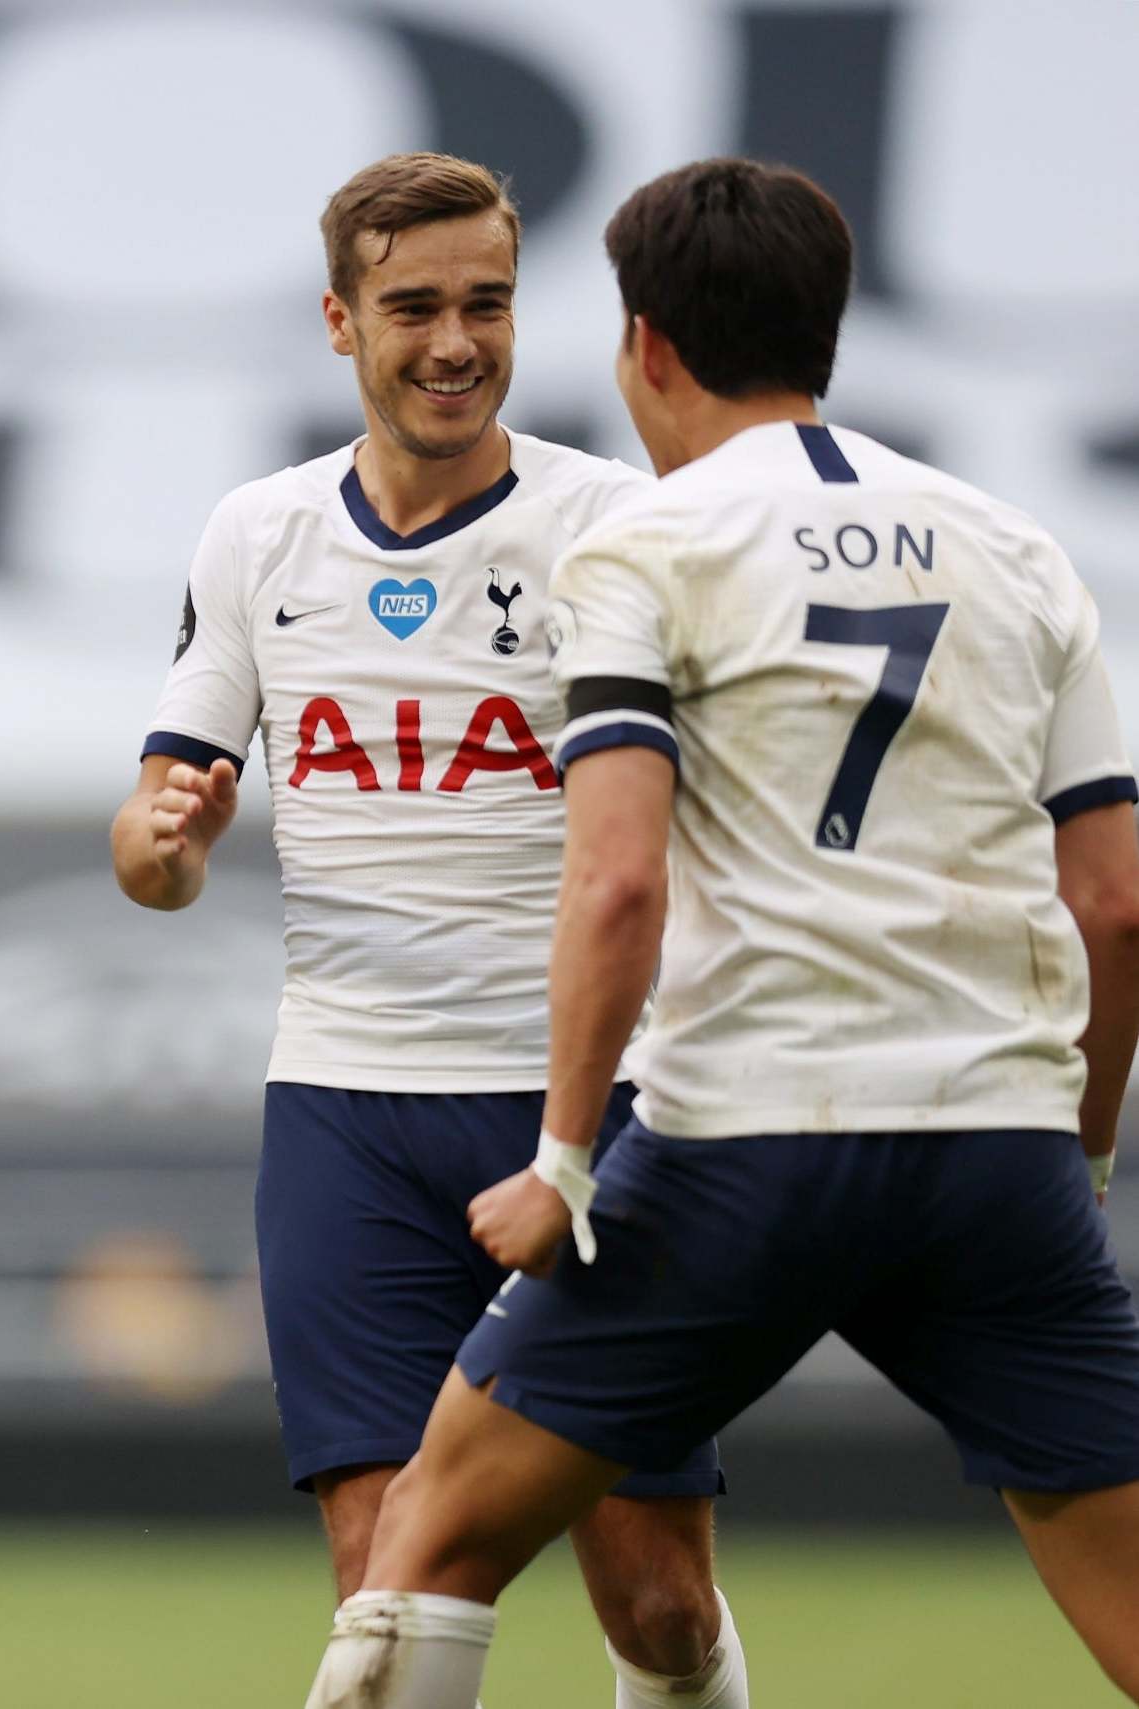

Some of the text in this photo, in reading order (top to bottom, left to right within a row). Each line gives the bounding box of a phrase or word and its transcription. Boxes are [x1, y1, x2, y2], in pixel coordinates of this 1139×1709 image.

[794, 523, 934, 571] SON
[382, 597, 425, 613] NHS
[288, 696, 562, 792] AIA
[804, 603, 950, 852] 7
